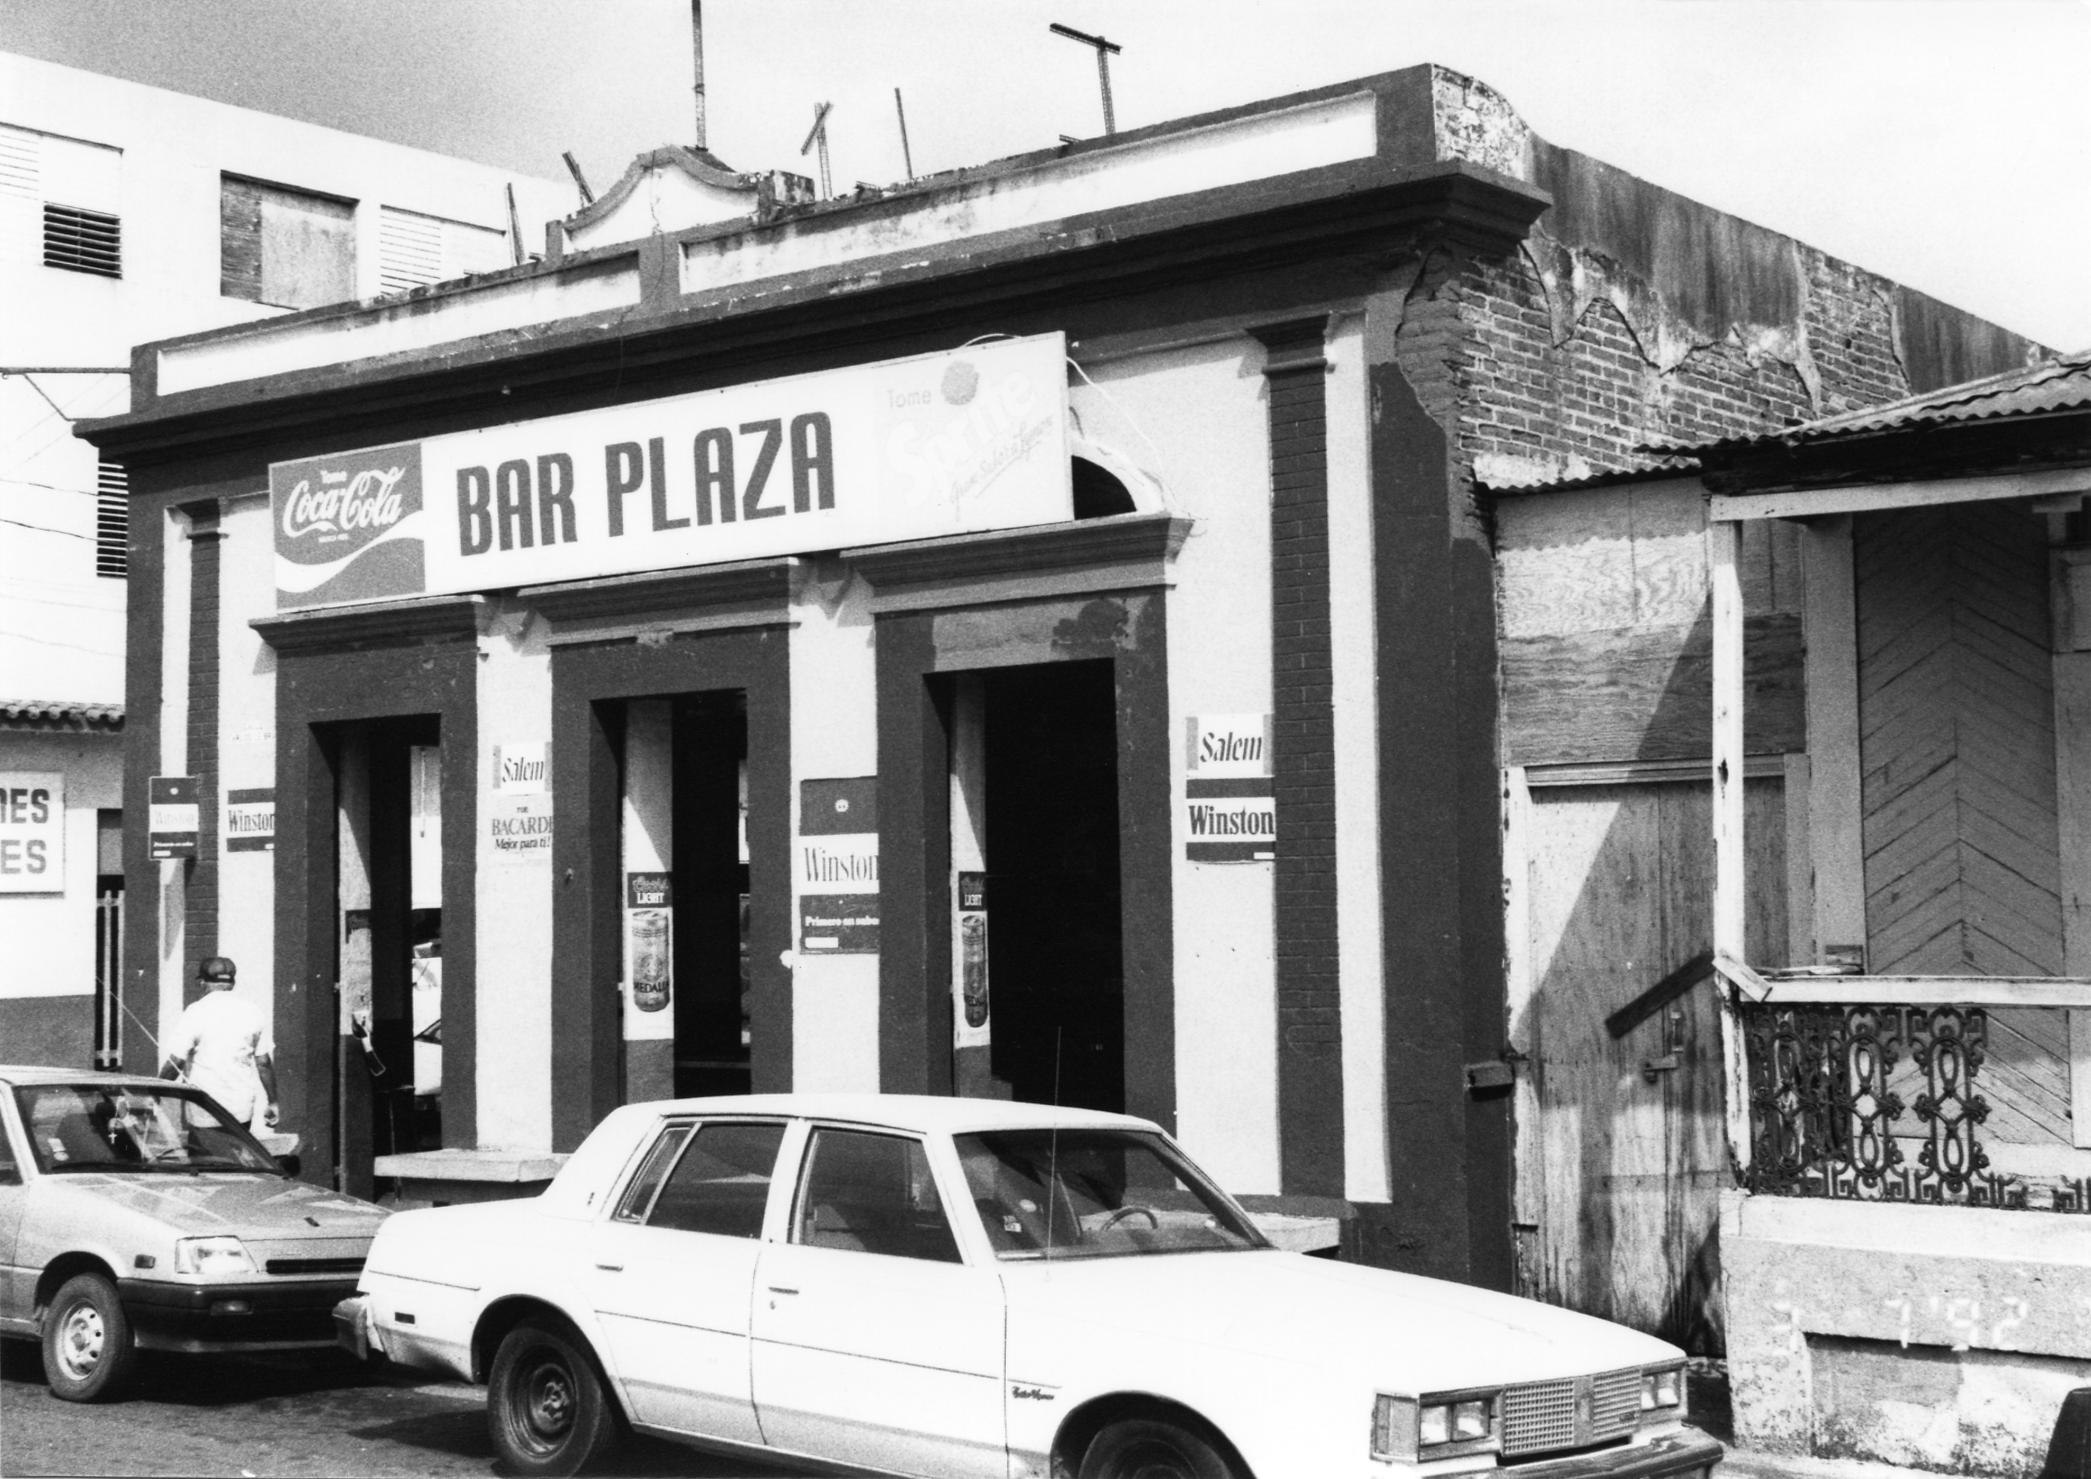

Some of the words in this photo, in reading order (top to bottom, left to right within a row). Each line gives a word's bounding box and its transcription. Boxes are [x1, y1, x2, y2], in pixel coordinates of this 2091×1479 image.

[887, 388, 932, 409] Tome
[456, 452, 578, 557] BAR
[605, 411, 836, 538] PLAZA
[282, 466, 406, 538] Coca-Cola
[1200, 731, 1262, 763] Salem
[502, 757, 544, 782] Salem
[1188, 805, 1275, 835] Winston
[520, 839, 538, 852] para
